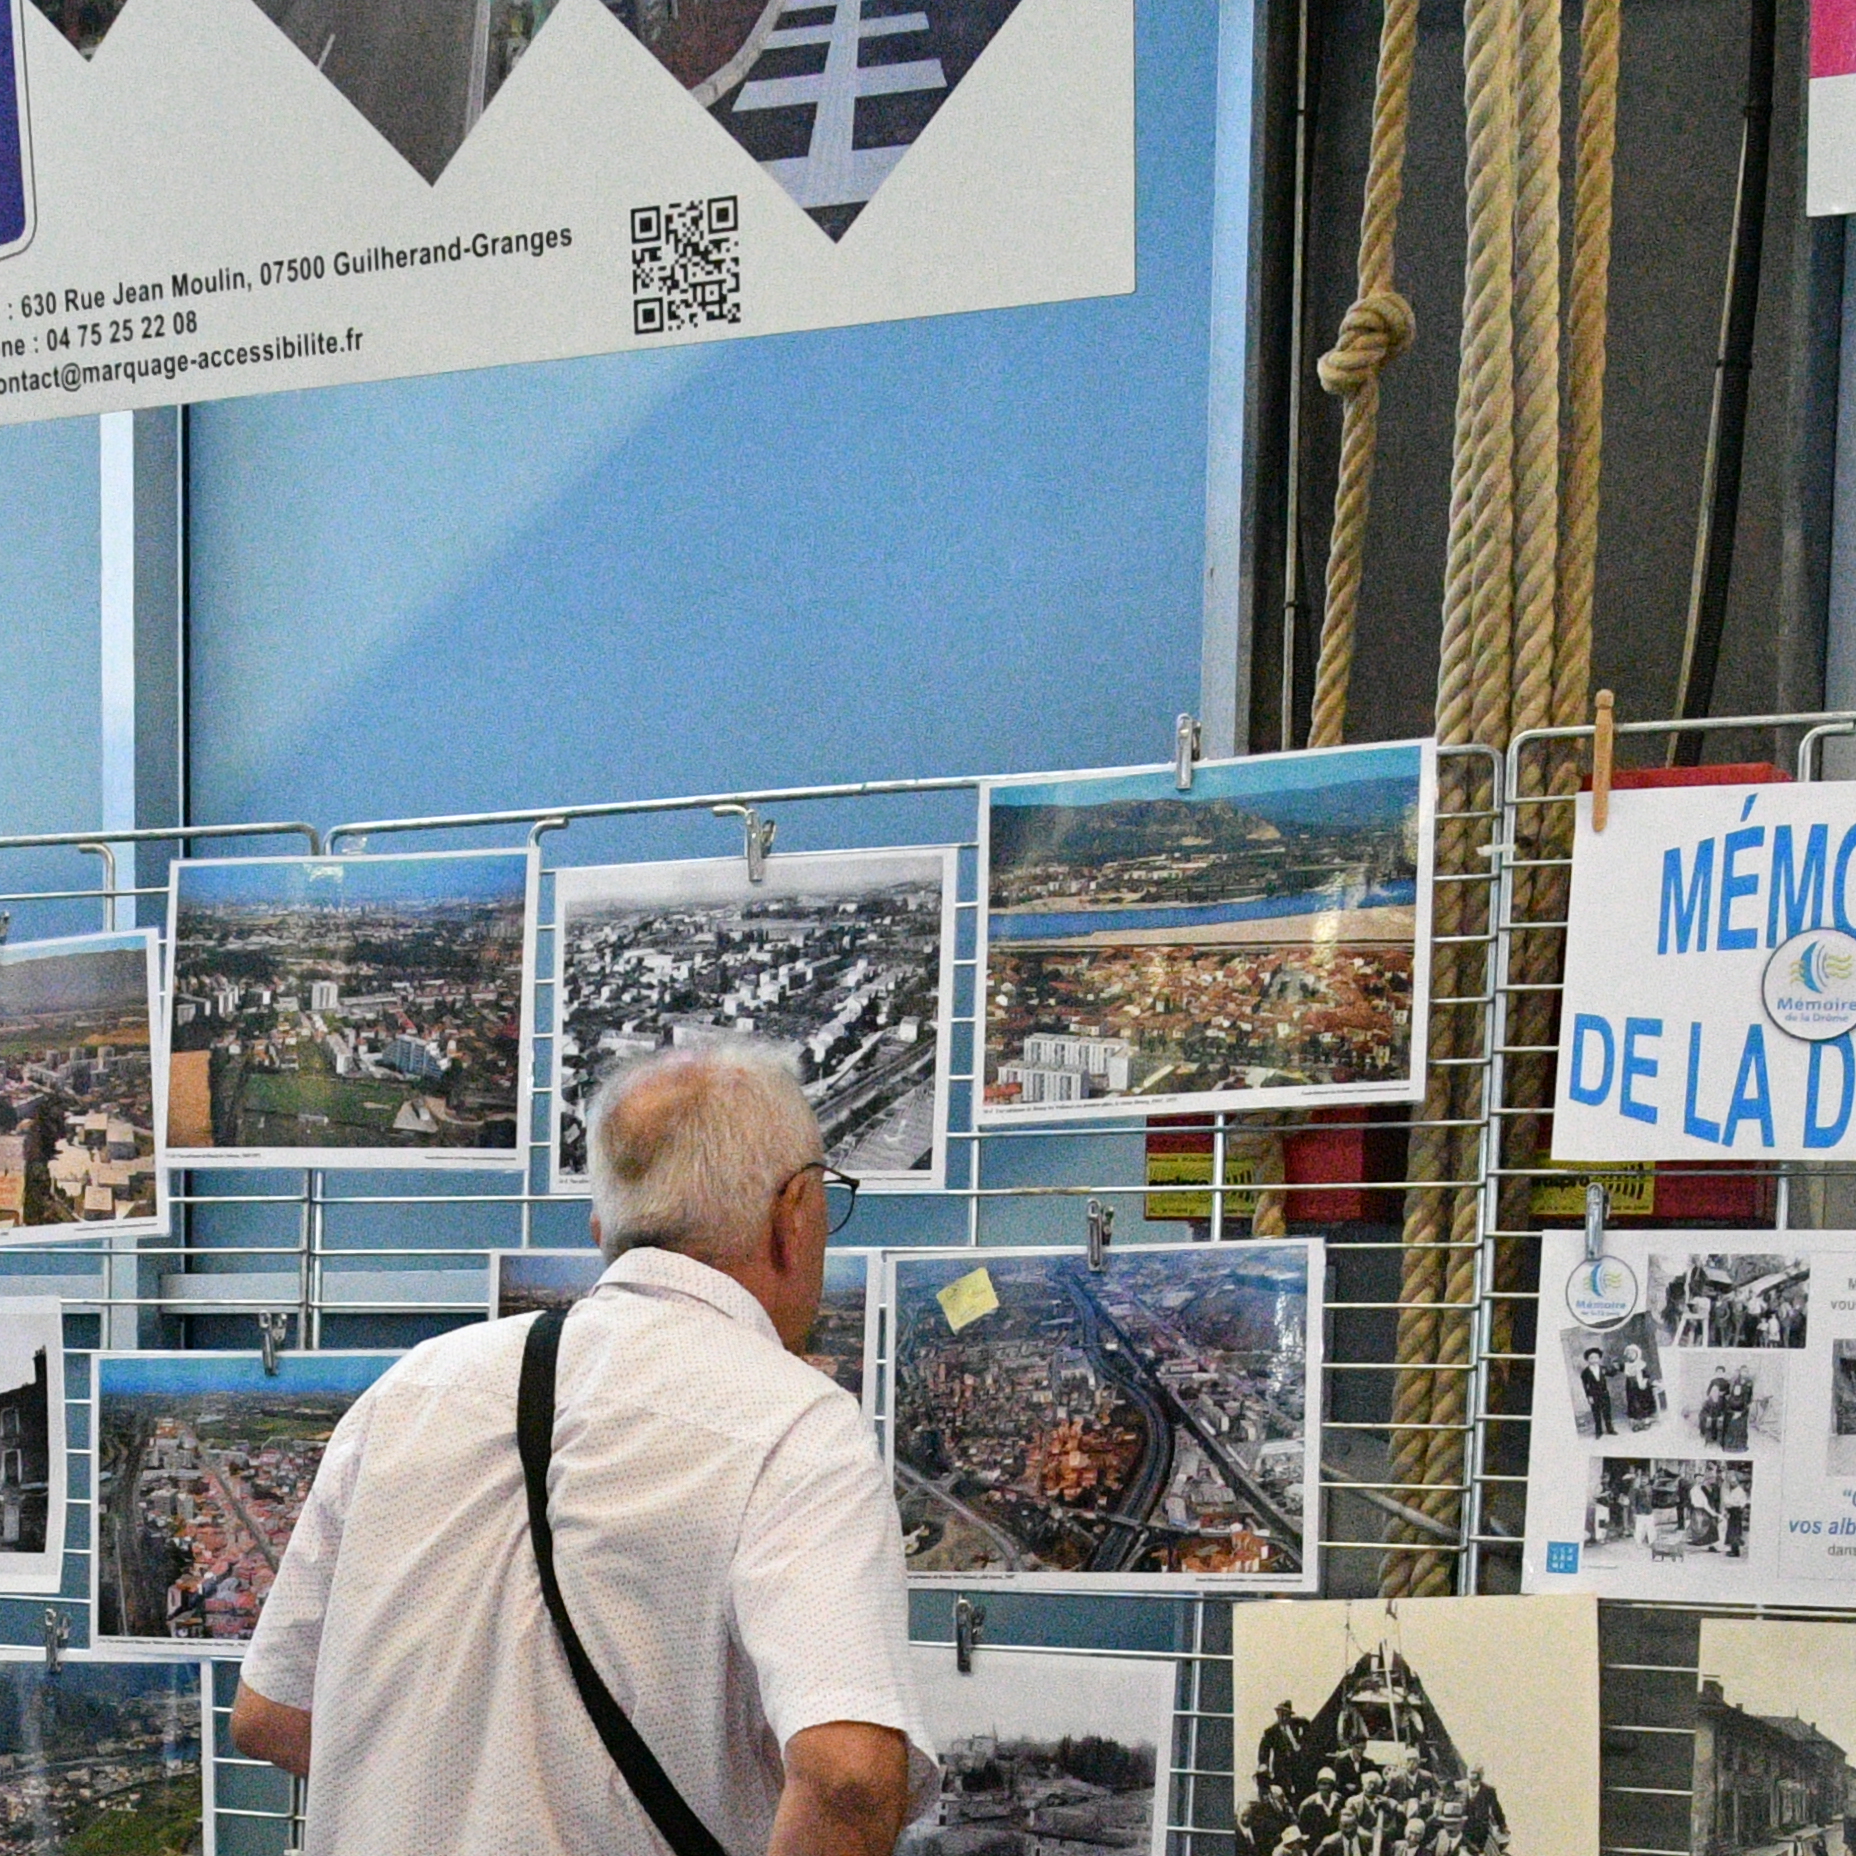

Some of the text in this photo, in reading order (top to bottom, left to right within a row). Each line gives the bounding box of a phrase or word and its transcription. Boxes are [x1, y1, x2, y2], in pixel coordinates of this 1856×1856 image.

[21, 292, 57, 318] 630
[64, 288, 105, 313] Rue
[112, 281, 164, 306] Jean
[171, 267, 252, 299] Moulin,
[259, 255, 325, 286] 07500
[333, 227, 573, 277] Guilherand-Granges
[46, 327, 71, 352] 04
[77, 322, 103, 348] 75
[109, 318, 135, 344] 25
[141, 314, 166, 340] 22
[173, 310, 198, 335] 08
[1569, 1012, 1663, 1125] DE
[1684, 1021, 1775, 1147] LA
[1789, 1518, 1822, 1535] vos
